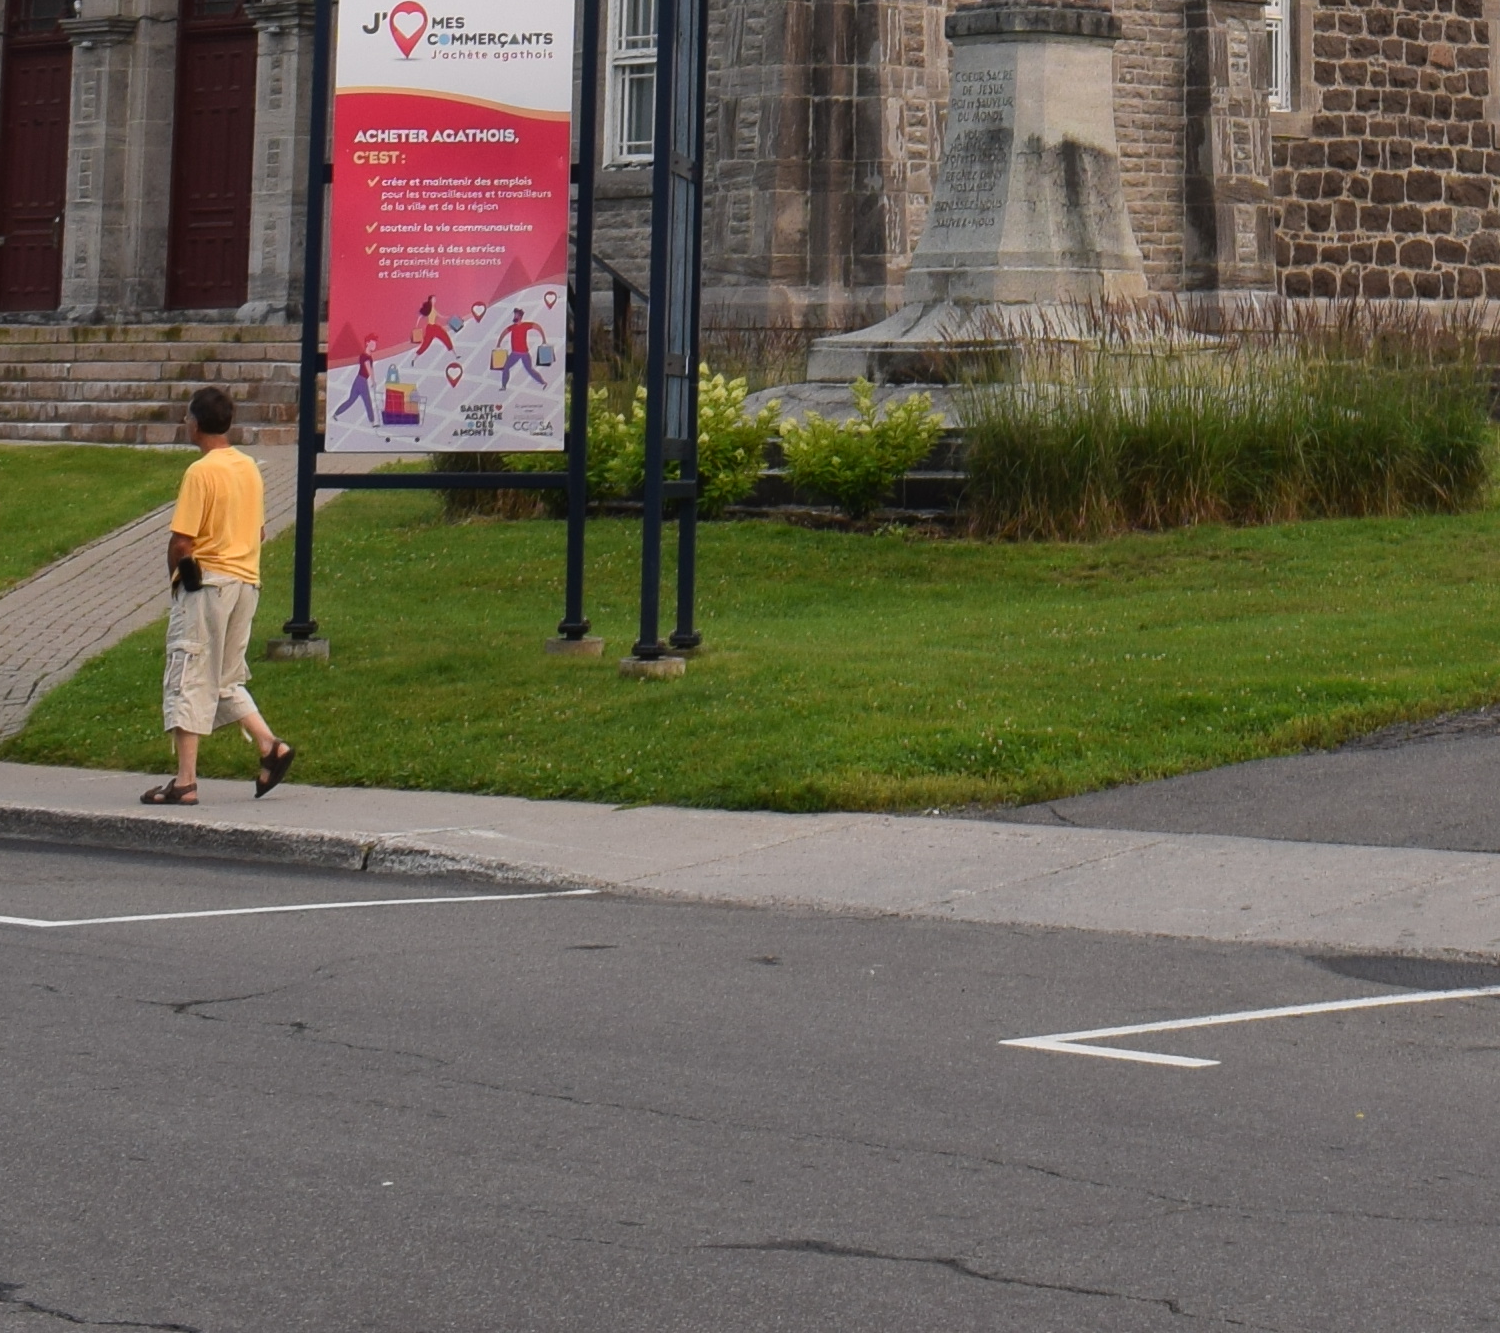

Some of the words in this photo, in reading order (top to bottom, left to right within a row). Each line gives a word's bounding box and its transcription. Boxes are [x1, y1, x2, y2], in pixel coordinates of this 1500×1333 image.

[431, 16, 465, 29] MES
[427, 32, 554, 49] COMMERÇANTS
[431, 49, 488, 60] J'achète
[493, 49, 554, 61] agathois
[962, 85, 974, 96] DE
[979, 83, 1004, 95] JESUS
[353, 129, 429, 144] ACHETER
[430, 129, 520, 144] AGATHOIS,
[381, 176, 407, 186] créer
[409, 178, 420, 186] et
[422, 177, 472, 186] maintenir
[474, 176, 491, 186] des
[493, 176, 532, 188] emplois
[381, 191, 403, 200] pour
[406, 190, 420, 199] les
[422, 189, 483, 199] travailleuses
[484, 190, 496, 199] et
[498, 189, 552, 199] travailleurs
[380, 202, 393, 211] de
[395, 202, 405, 211] la
[407, 202, 426, 211] ville
[428, 203, 439, 211] et
[441, 202, 453, 211] de
[455, 202, 465, 211] la
[467, 202, 498, 213] région
[379, 223, 421, 232] soutenir
[423, 223, 433, 232] la
[435, 223, 450, 232] vie
[452, 222, 533, 232] communautaire
[379, 244, 404, 254] avoir
[407, 244, 435, 253] accès
[437, 244, 444, 253] à
[446, 244, 463, 253] des
[466, 244, 506, 253] services
[378, 257, 391, 266] de
[393, 257, 439, 268] proximité
[442, 256, 502, 266] intéressants
[378, 270, 389, 279] et
[391, 270, 440, 279] diversifiés
[460, 404, 495, 413] SAINTE
[465, 412, 503, 420] AGATHE
[475, 420, 494, 429] DES
